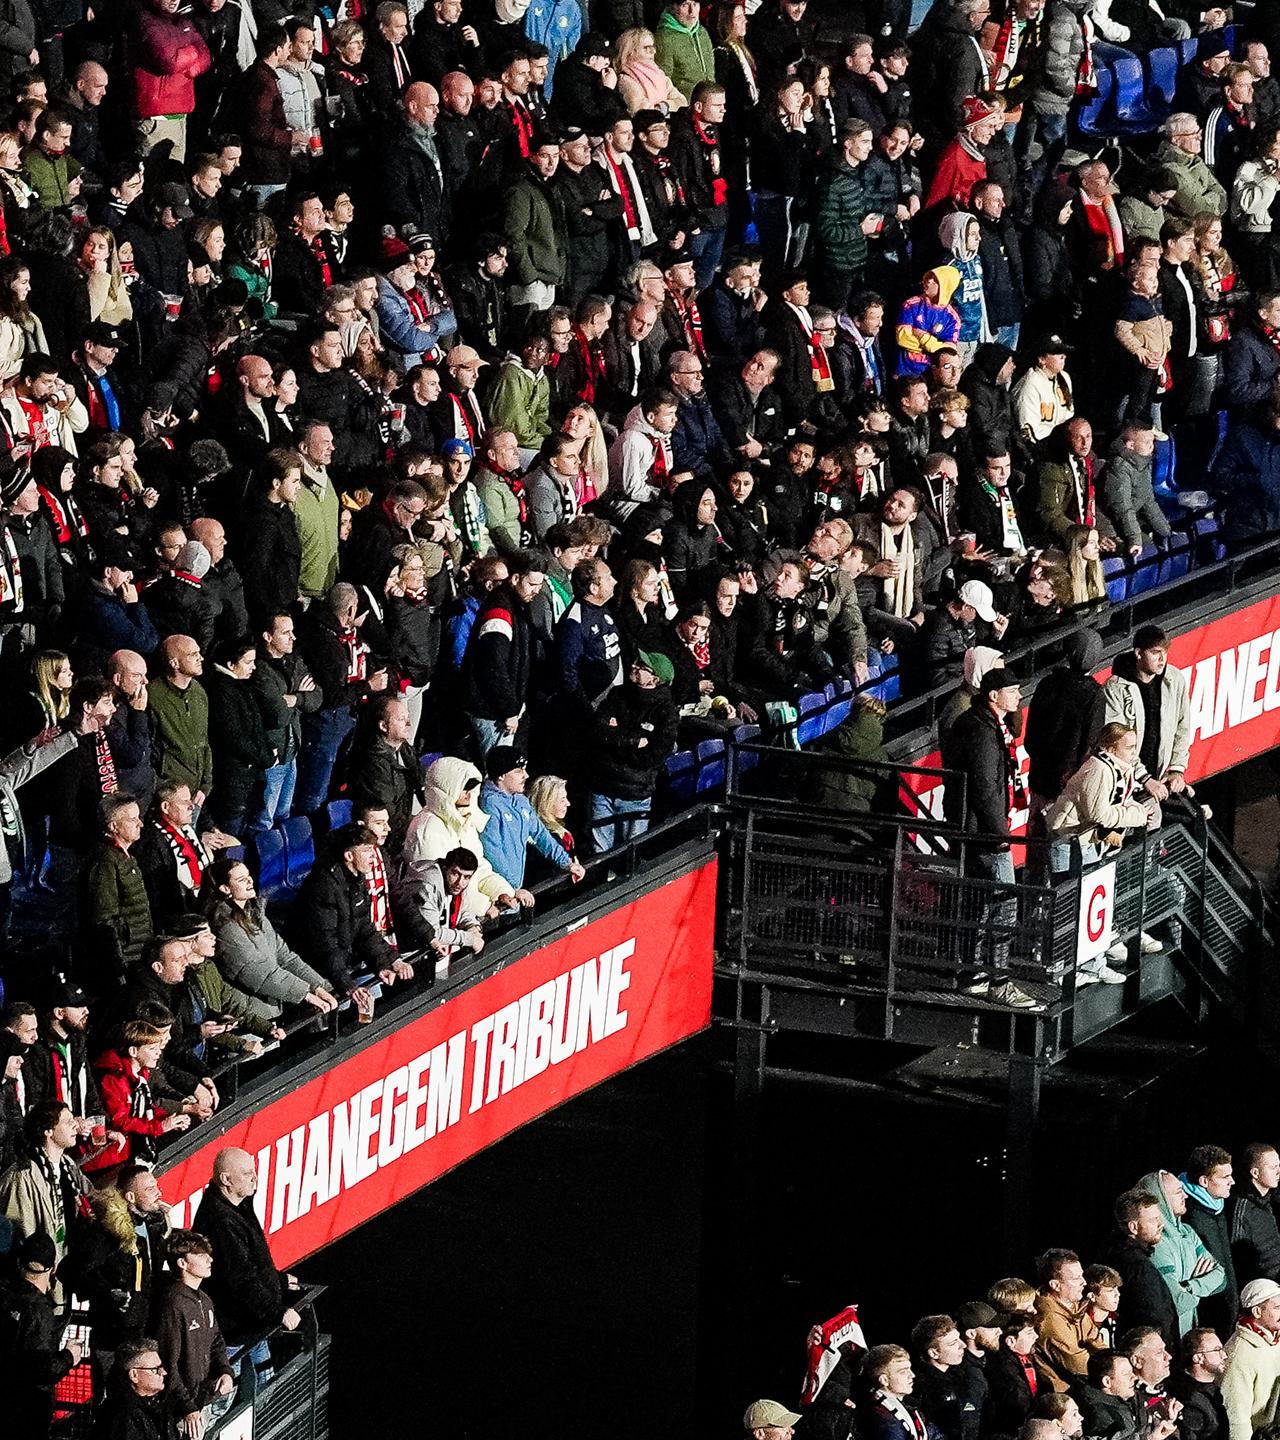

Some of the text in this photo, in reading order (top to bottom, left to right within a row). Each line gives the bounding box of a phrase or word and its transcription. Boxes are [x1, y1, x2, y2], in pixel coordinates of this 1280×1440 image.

[1087, 884, 1106, 943] G
[268, 1028, 468, 1235] HANEGEM
[468, 937, 637, 1115] TRIBUNE
